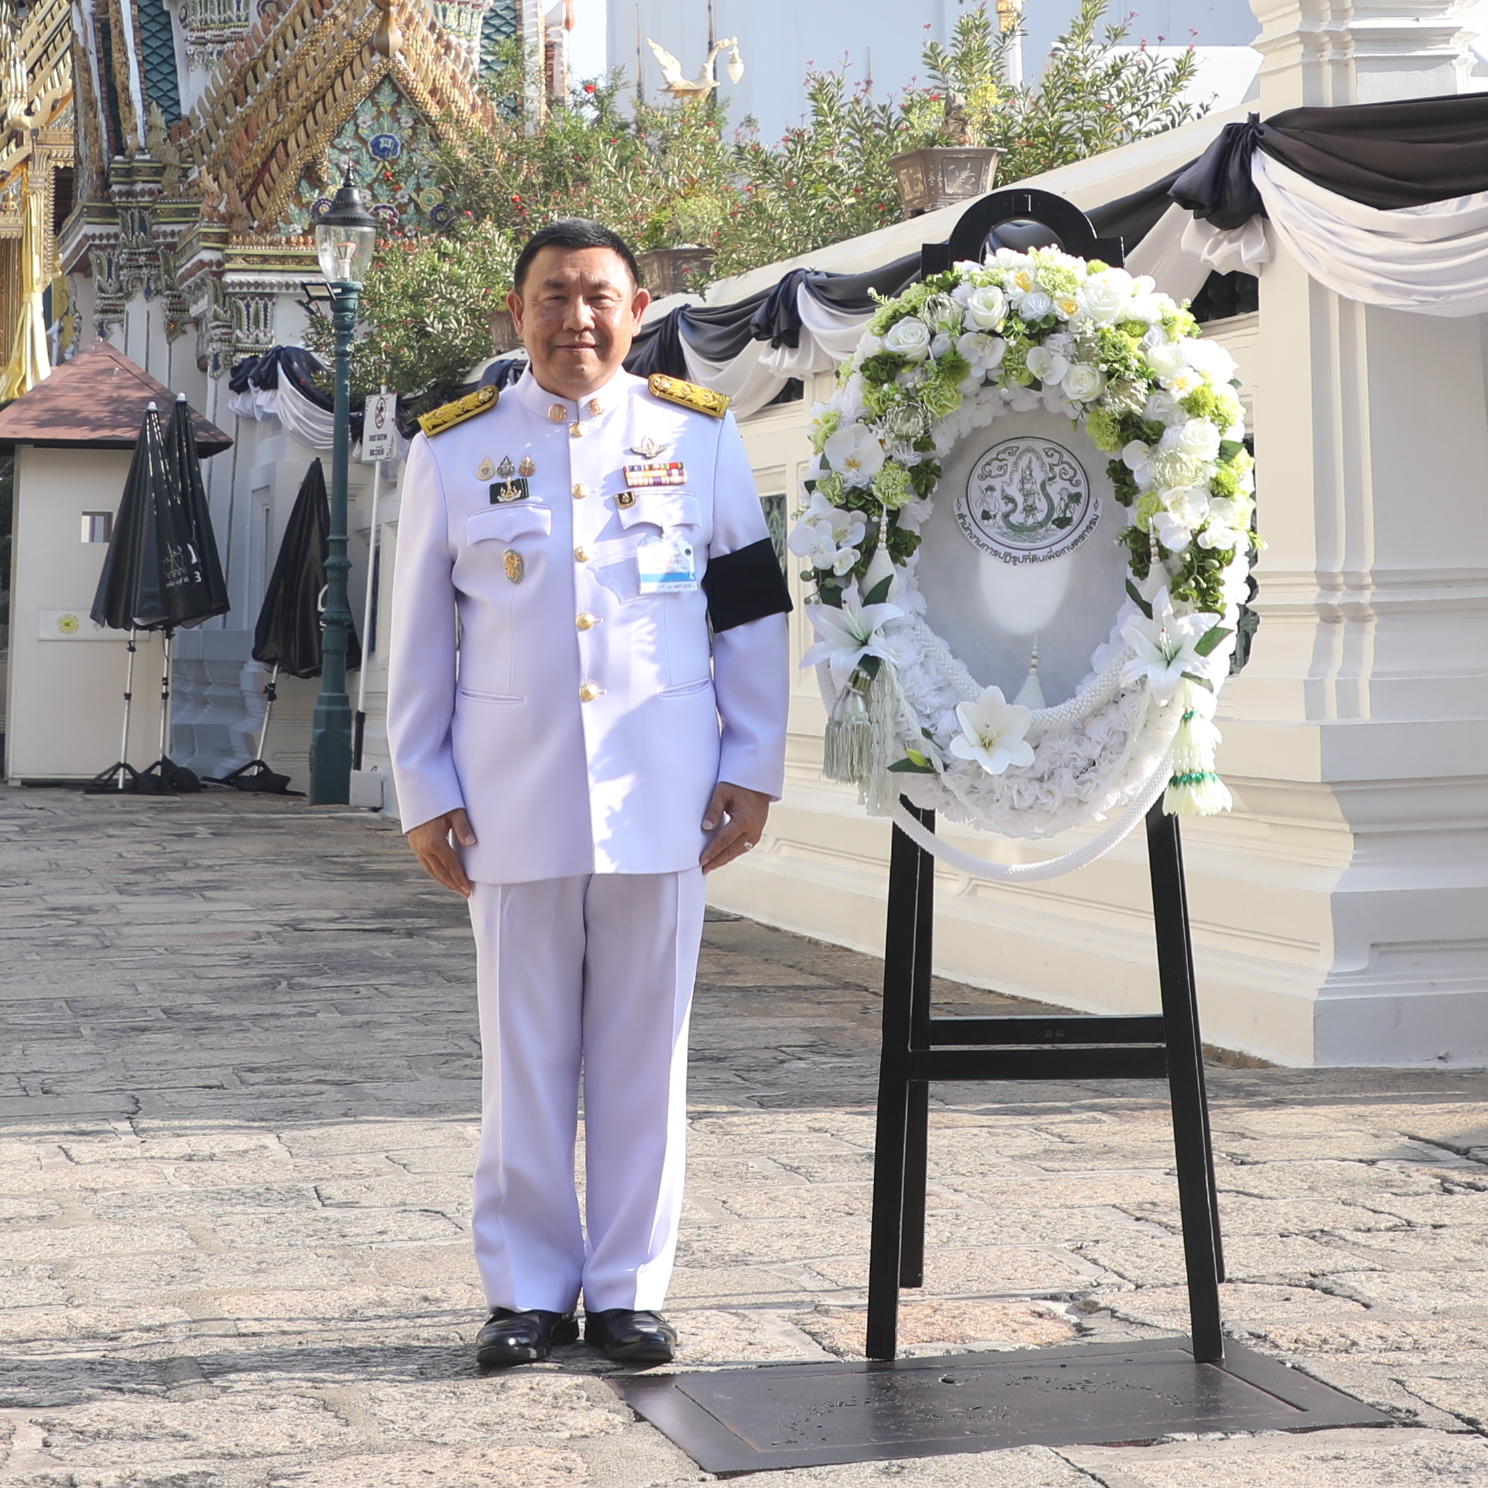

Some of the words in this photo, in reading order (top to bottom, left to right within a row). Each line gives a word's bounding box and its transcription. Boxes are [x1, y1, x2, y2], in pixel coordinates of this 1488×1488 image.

[956, 512, 1100, 566] สำนักงานการปฏิรูปที่ดินเพื่อเกษตรกรรม
